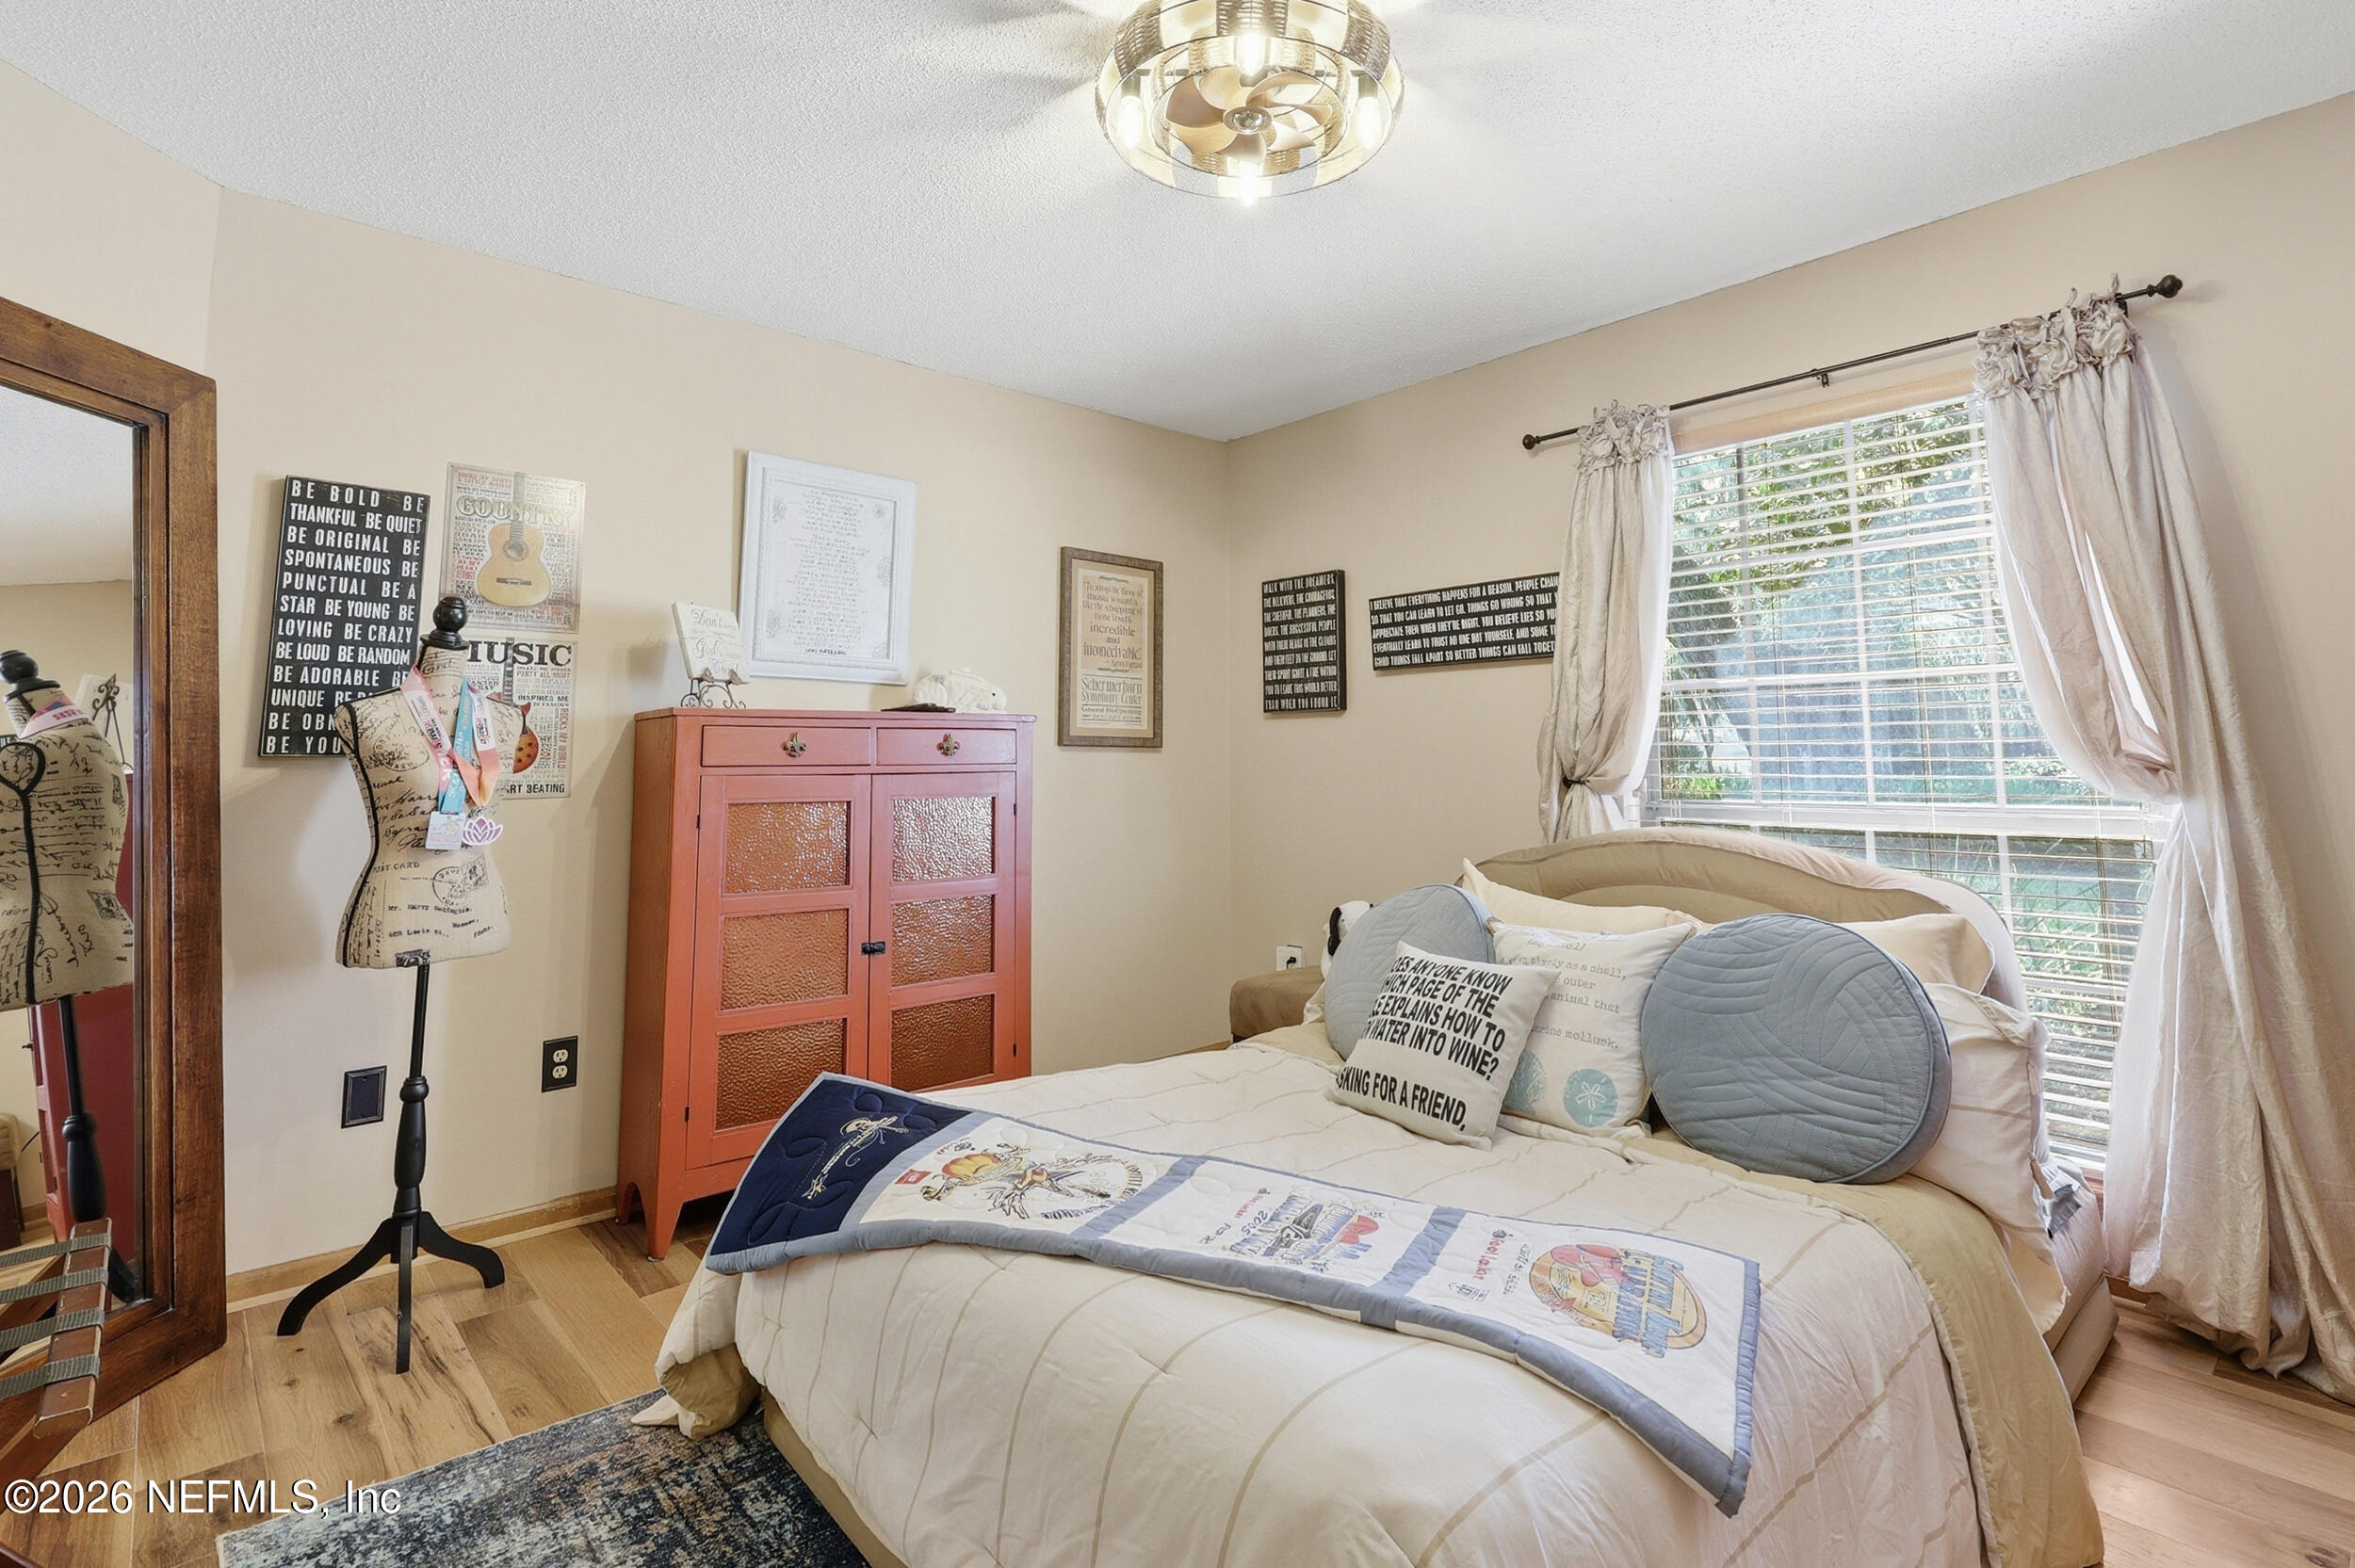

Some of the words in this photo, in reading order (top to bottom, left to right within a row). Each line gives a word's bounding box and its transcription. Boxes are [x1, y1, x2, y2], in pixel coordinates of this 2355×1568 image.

[291, 479, 315, 499] BE
[330, 485, 381, 508] BOLD
[403, 495, 424, 513] BE
[290, 502, 357, 527] THANKFUL
[365, 511, 382, 530] BE
[386, 514, 422, 535] QUIET
[286, 525, 307, 544] BE
[315, 528, 389, 554] ORIGINAL
[402, 539, 421, 557] BE
[284, 548, 392, 576] SPONTANEOUS
[401, 560, 418, 578] BE
[283, 571, 367, 596] PUNCTUAL
[381, 580, 401, 599] BE
[407, 583, 416, 601] A
[1441, 588, 1468, 601] HAPPENS
[1470, 586, 1481, 598] FOR
[1483, 586, 1486, 597] A
[1515, 577, 1539, 591] PEOPLE
[280, 595, 317, 614] STAR
[324, 599, 343, 617] BE
[347, 599, 391, 620] YOUNG
[398, 605, 414, 622] BE
[1490, 599, 1500, 610] GO
[1500, 597, 1524, 609] WRONG
[1526, 595, 1535, 606] SO
[1535, 592, 1552, 605] THAT
[1089, 622, 1136, 637] incredible
[1481, 616, 1494, 627] YOU
[1494, 612, 1519, 625] BELIEVE
[1520, 610, 1534, 623] LIES
[1535, 610, 1545, 622] SO
[277, 618, 333, 639] LOVING
[344, 622, 363, 640] BE
[367, 623, 413, 644] CRAZY
[1516, 627, 1530, 639] AND
[275, 641, 294, 660] BE
[296, 642, 330, 662] LOUD
[337, 644, 355, 663] BE
[358, 646, 411, 666] RANDOM
[1445, 650, 1454, 661] SO
[1454, 648, 1477, 661] BETTER
[1479, 646, 1502, 658] THINGS
[1502, 644, 1517, 656] CAN
[1518, 642, 1532, 655] FALL
[273, 665, 294, 684] BE
[300, 666, 381, 687] ADORABLE
[271, 687, 325, 708] UNIQUE
[268, 712, 290, 731] BE
[266, 736, 290, 754] BE
[526, 784, 565, 794] BEATING
[394, 861, 420, 870] CARD
[1408, 959, 1468, 982] ANYONE
[1463, 968, 1513, 996] KNOW
[1566, 962, 1578, 970] as
[1590, 964, 1627, 981] shell,
[1564, 978, 1596, 990] outer
[1405, 975, 1445, 1000] PAGE
[1442, 983, 1466, 1005] OF
[1464, 988, 1500, 1019] THE
[1551, 992, 1590, 1006] animal
[1594, 998, 1620, 1014] that
[1381, 994, 1443, 1026] EXPLAINS
[1441, 1006, 1483, 1040] HOW
[1483, 1023, 1505, 1053] TO
[1369, 1018, 1411, 1045] WATER
[1409, 1025, 1447, 1057] INTO
[1447, 1040, 1500, 1081] WINE?
[1566, 1030, 1619, 1051] mollusk.
[1336, 1066, 1371, 1096] SKING
[1372, 1072, 1397, 1105] FOR
[1399, 1080, 1408, 1108] A
[1411, 1083, 1467, 1132] FRIEND.
